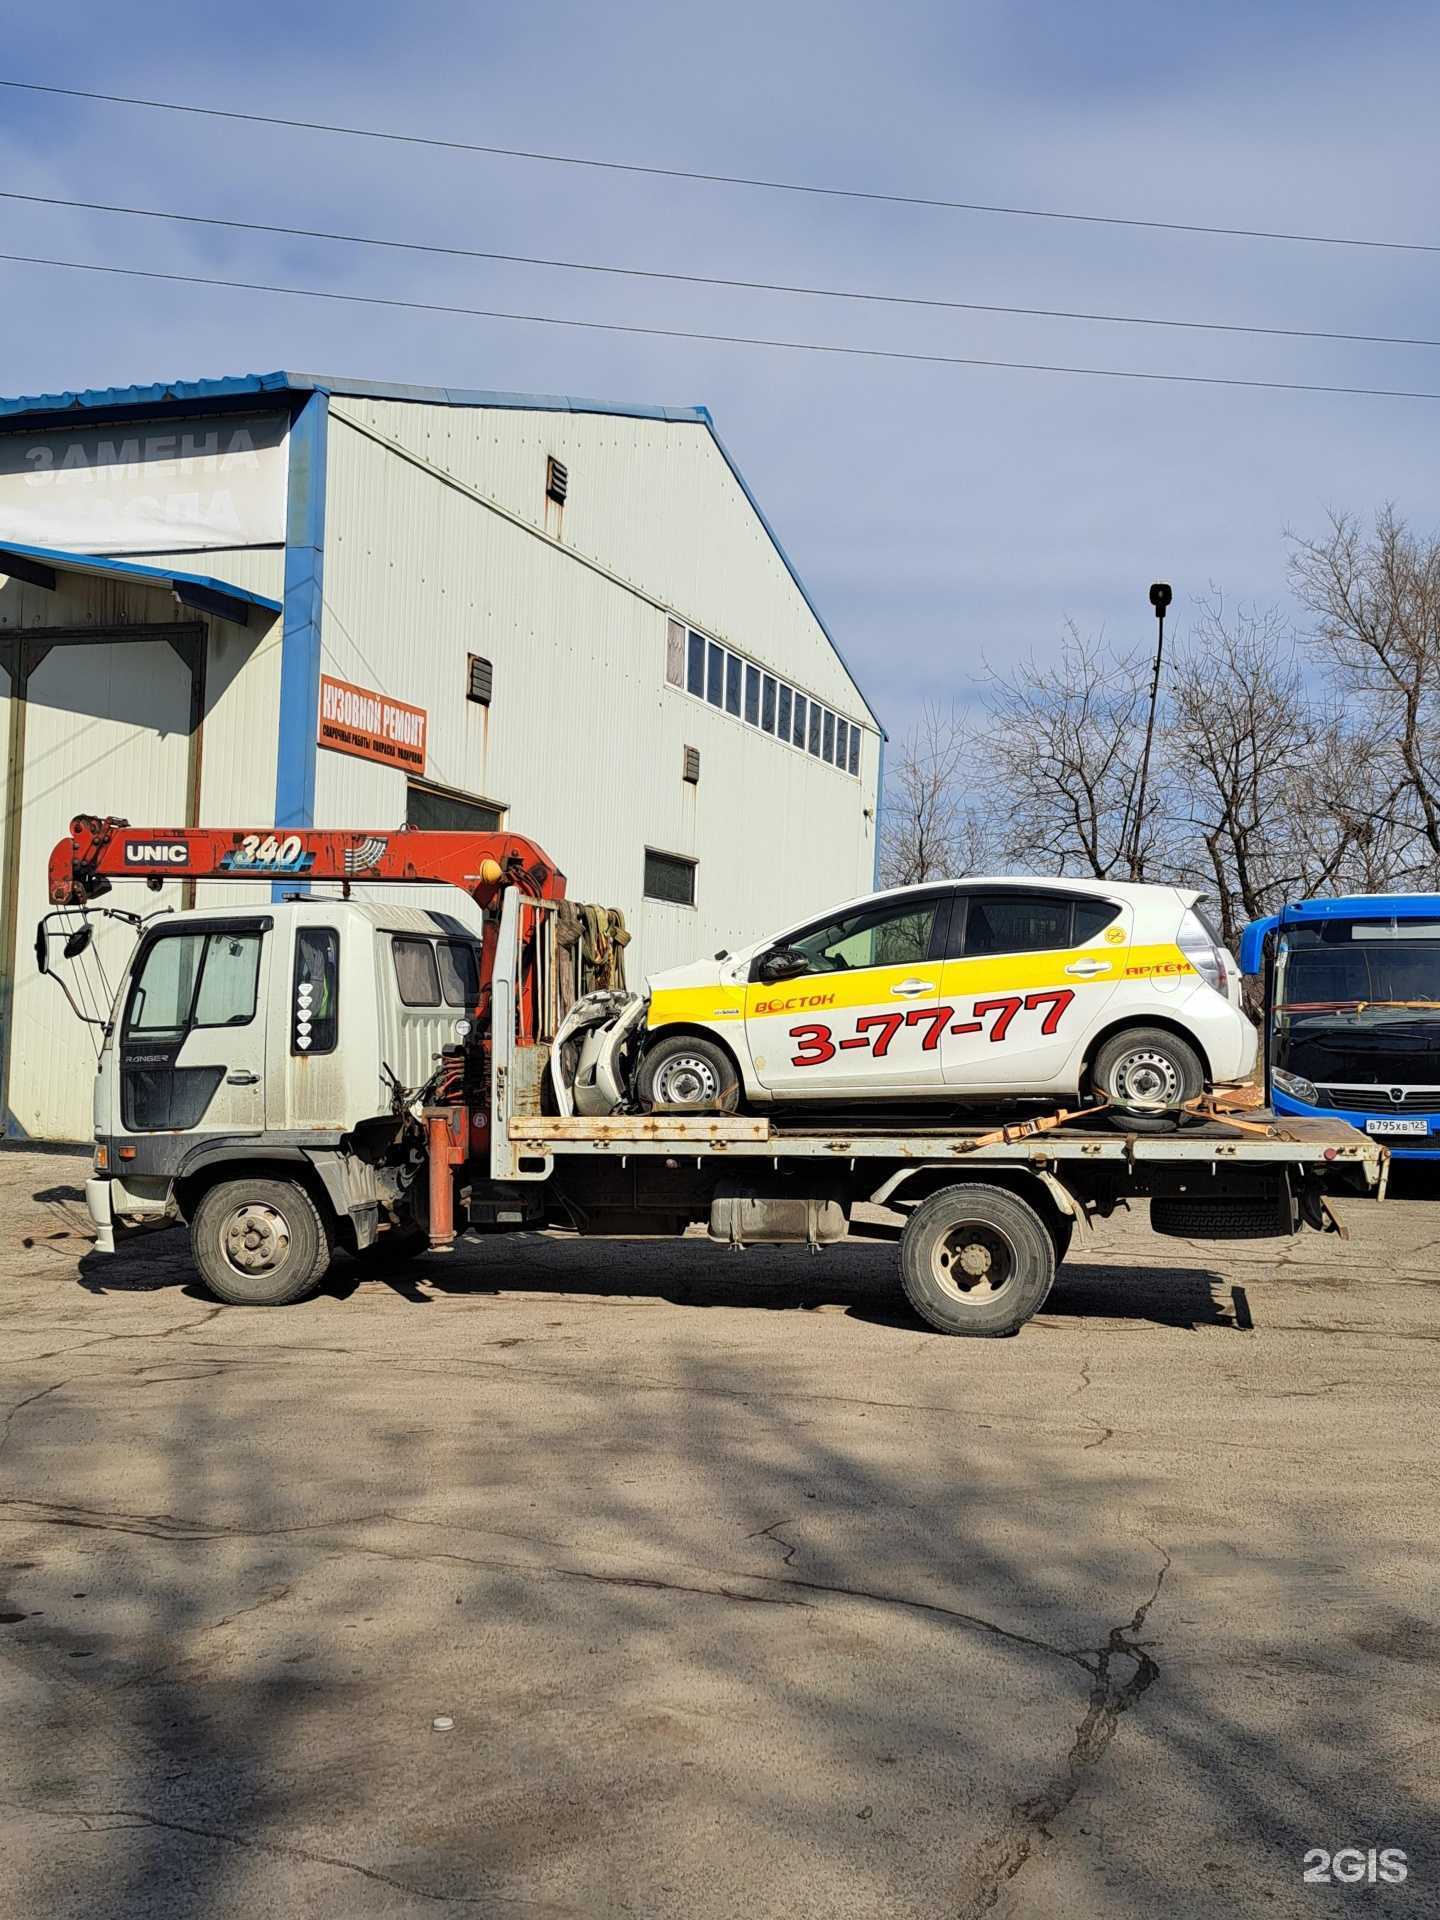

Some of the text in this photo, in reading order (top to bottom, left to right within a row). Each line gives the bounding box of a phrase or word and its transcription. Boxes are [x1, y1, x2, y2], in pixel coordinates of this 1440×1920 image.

[24, 429, 260, 487] ЗАМЕНА
[323, 683, 425, 748] КУЗОВНОЙ РЕМОНТ
[126, 845, 188, 862] UNIC
[233, 835, 302, 864] 340
[788, 989, 1076, 1067] 3-77-77
[125, 1055, 169, 1063] RANGER
